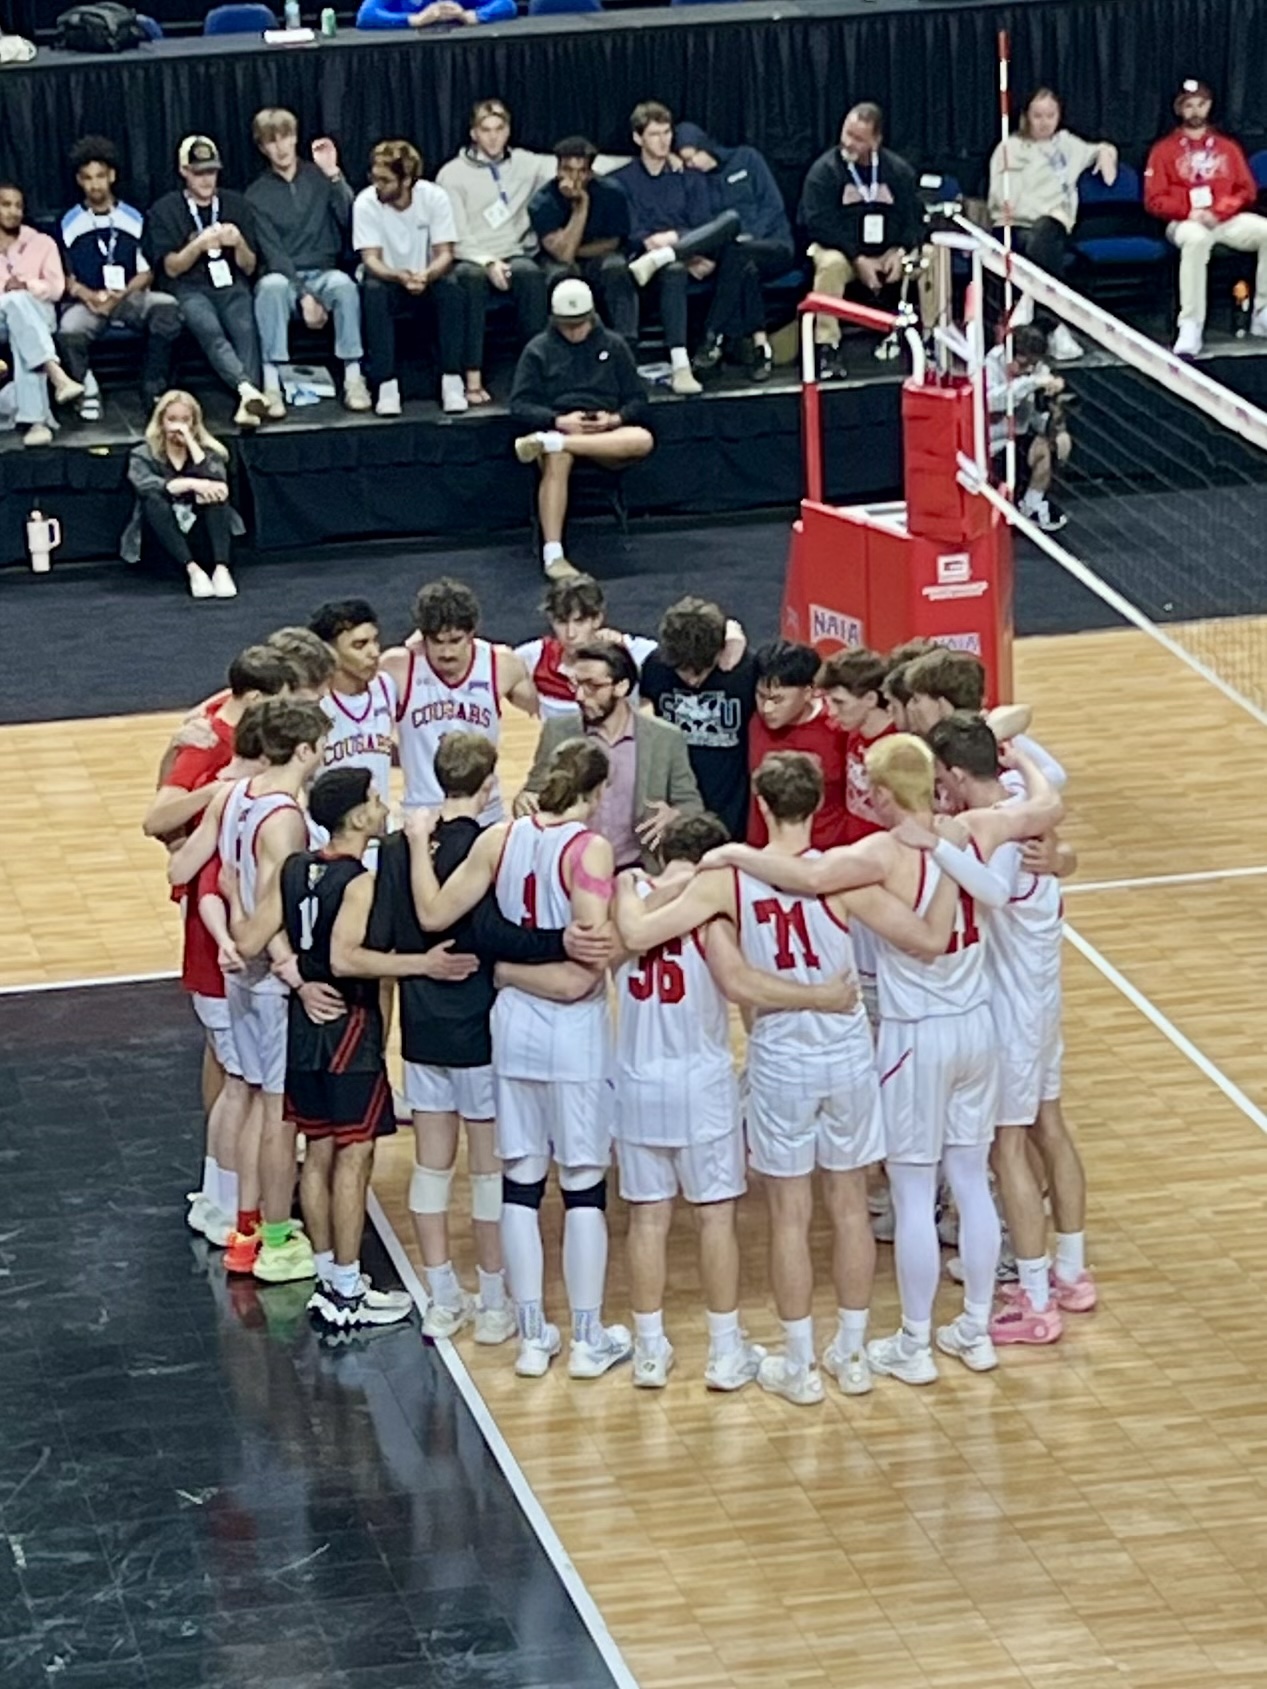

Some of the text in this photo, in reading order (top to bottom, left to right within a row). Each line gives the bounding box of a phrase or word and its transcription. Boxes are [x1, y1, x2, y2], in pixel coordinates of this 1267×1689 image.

[814, 610, 860, 646] NAIA
[411, 699, 491, 728] COUGARS
[752, 898, 820, 970] 71
